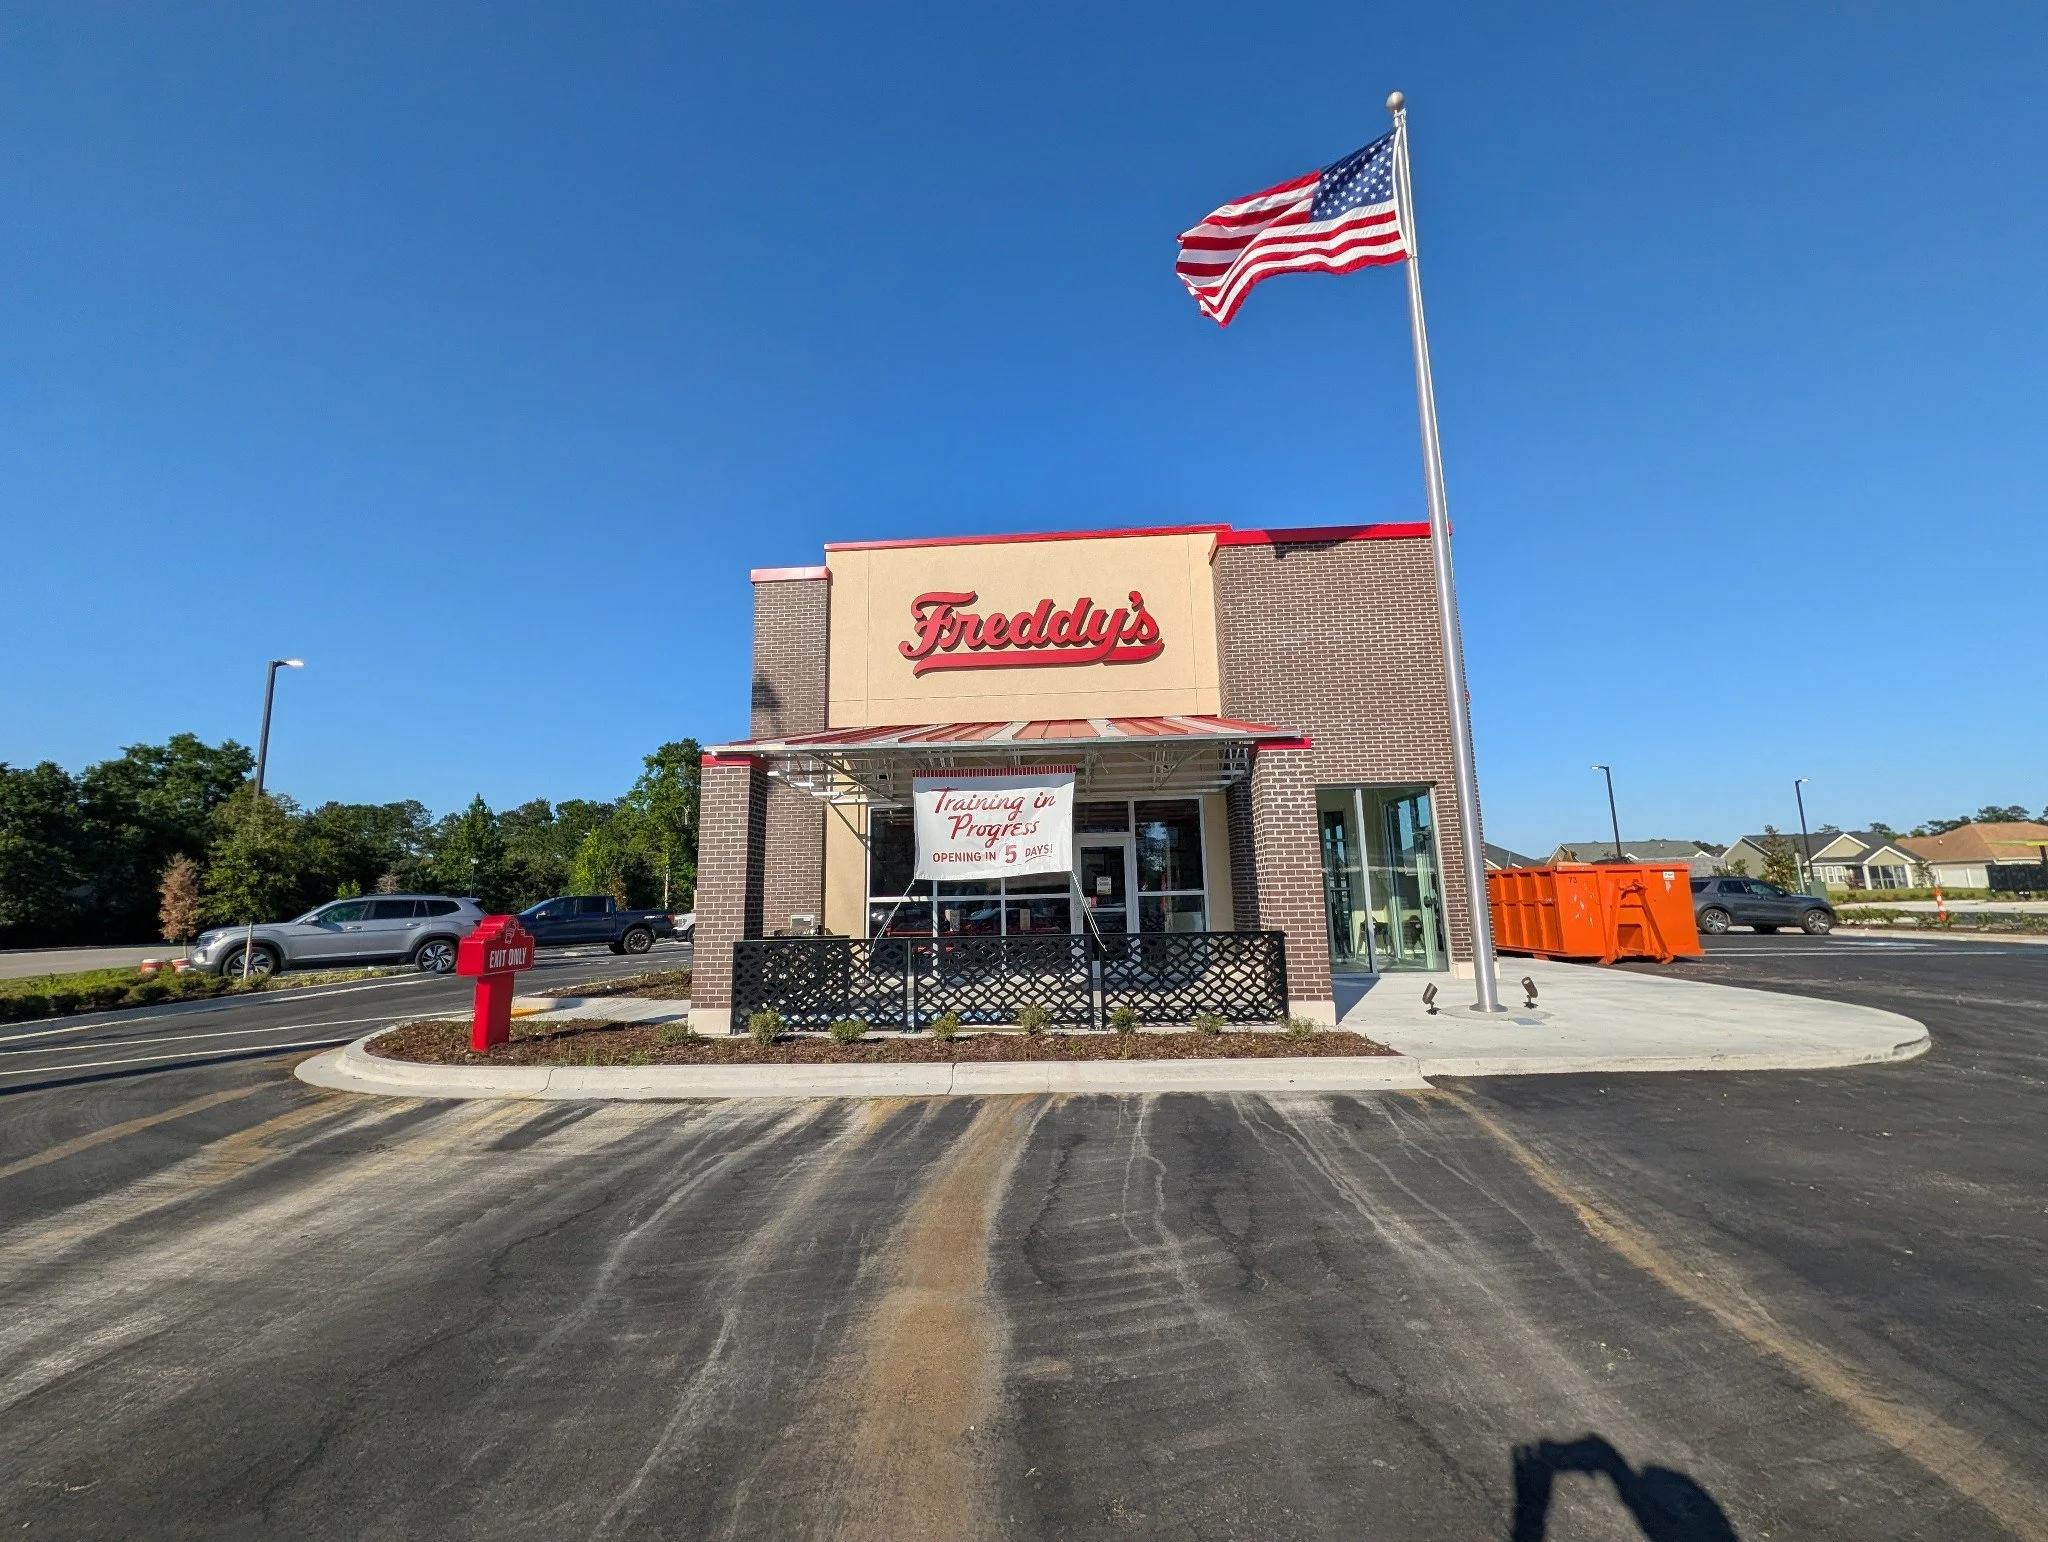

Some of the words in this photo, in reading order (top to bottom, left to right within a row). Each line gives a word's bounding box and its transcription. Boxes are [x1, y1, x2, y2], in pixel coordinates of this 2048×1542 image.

[898, 590, 1165, 678] Freddy's
[931, 787, 1025, 821] Training
[1033, 791, 1056, 809] in
[948, 813, 1040, 848] Progress
[932, 851, 982, 863] OPENING
[985, 851, 997, 862] IN
[1004, 844, 1017, 864] 5
[1024, 843, 1054, 858] DAYS!
[489, 949, 507, 969] EXIT
[508, 947, 527, 967] ONLY
